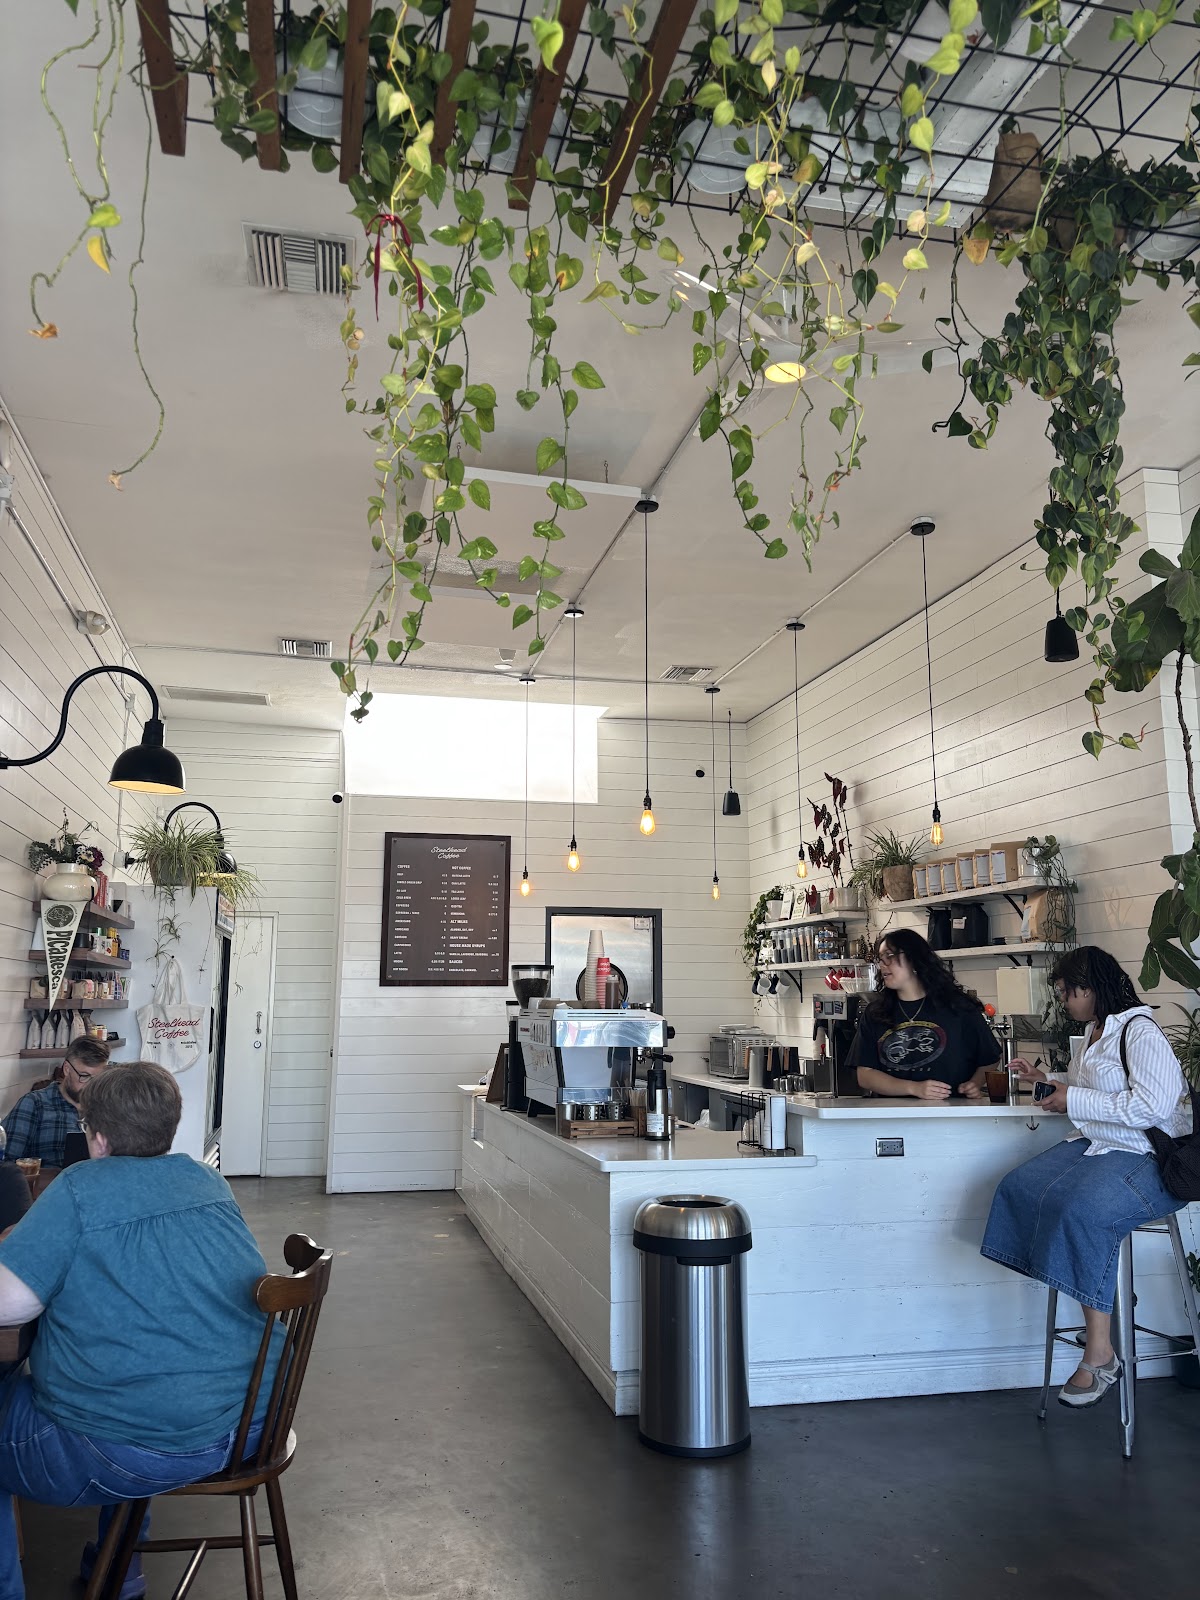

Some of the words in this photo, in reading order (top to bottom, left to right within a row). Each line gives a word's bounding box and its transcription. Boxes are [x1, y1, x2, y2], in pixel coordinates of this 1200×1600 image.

[437, 852, 460, 860] Coffee
[147, 1017, 201, 1029] Steelhead
[154, 1028, 190, 1039] Coffee
